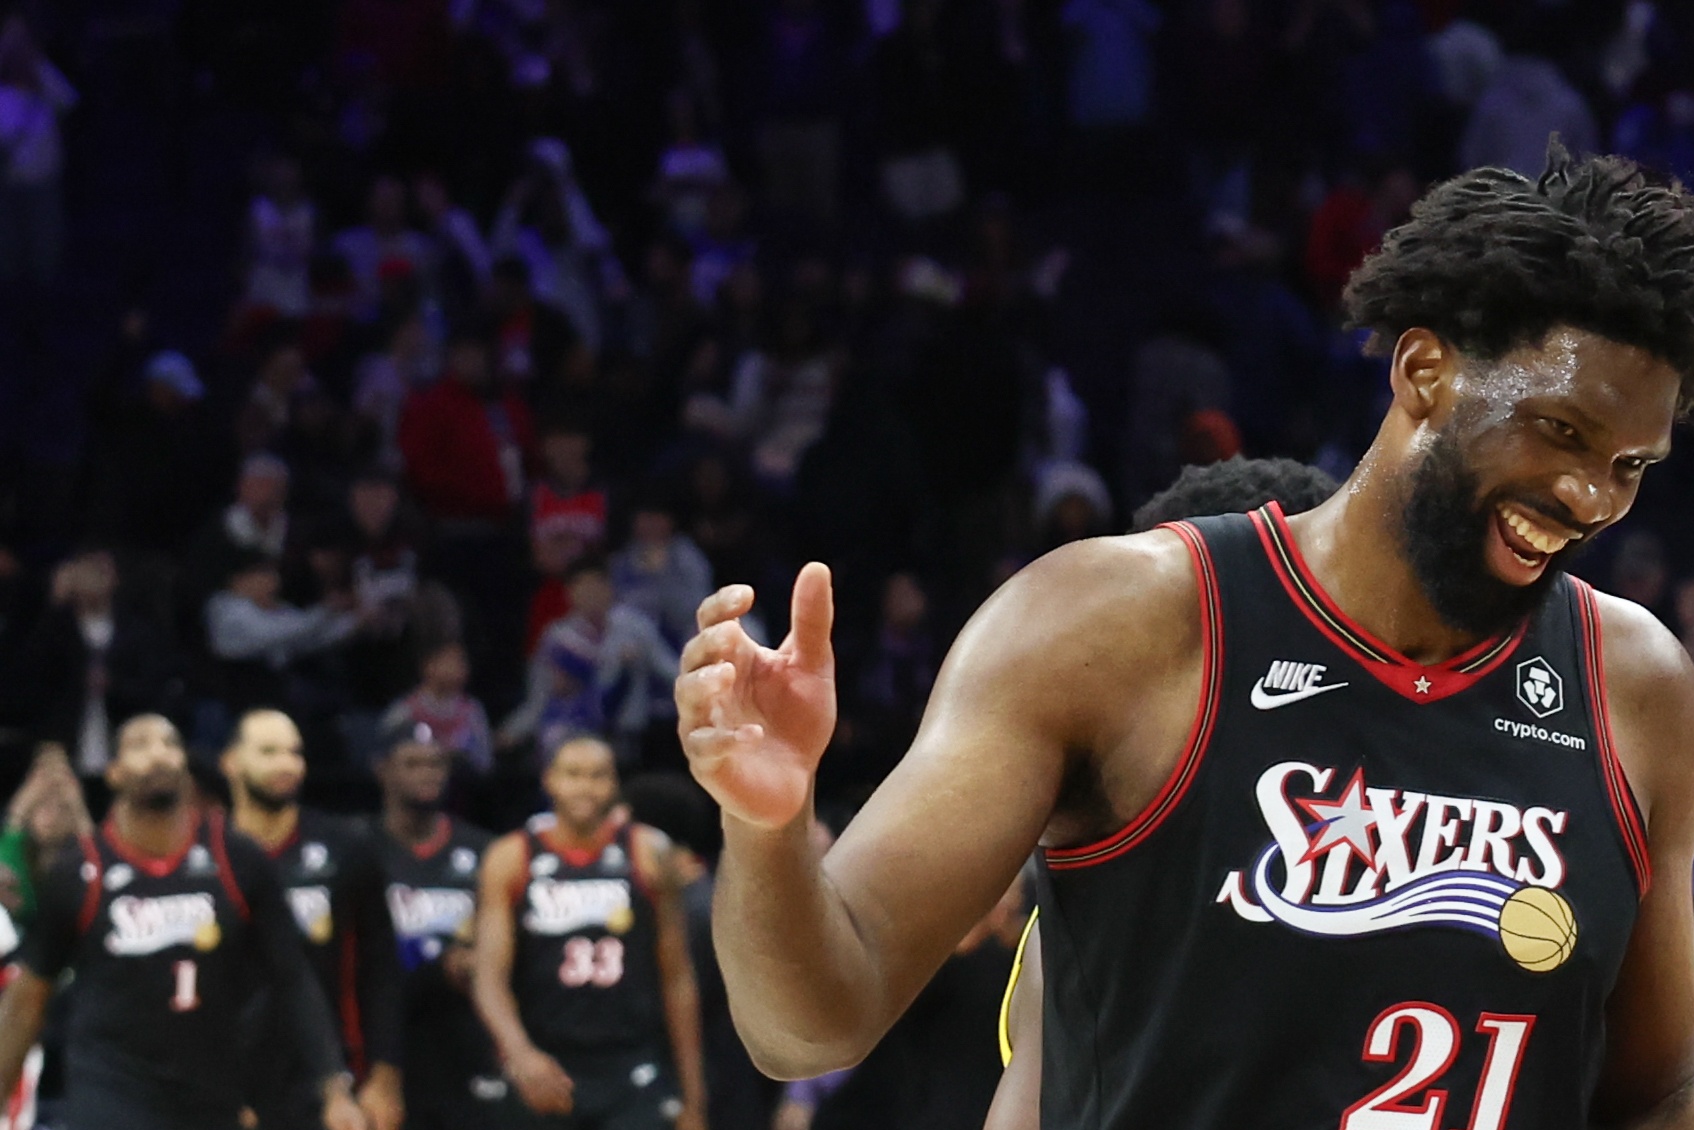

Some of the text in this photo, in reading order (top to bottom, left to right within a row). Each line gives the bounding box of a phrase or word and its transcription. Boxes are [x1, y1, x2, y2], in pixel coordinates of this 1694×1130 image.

[1263, 660, 1328, 692] NIKE
[1494, 717, 1586, 750] crypto.com
[558, 935, 625, 988] 33
[171, 959, 200, 1012] 1
